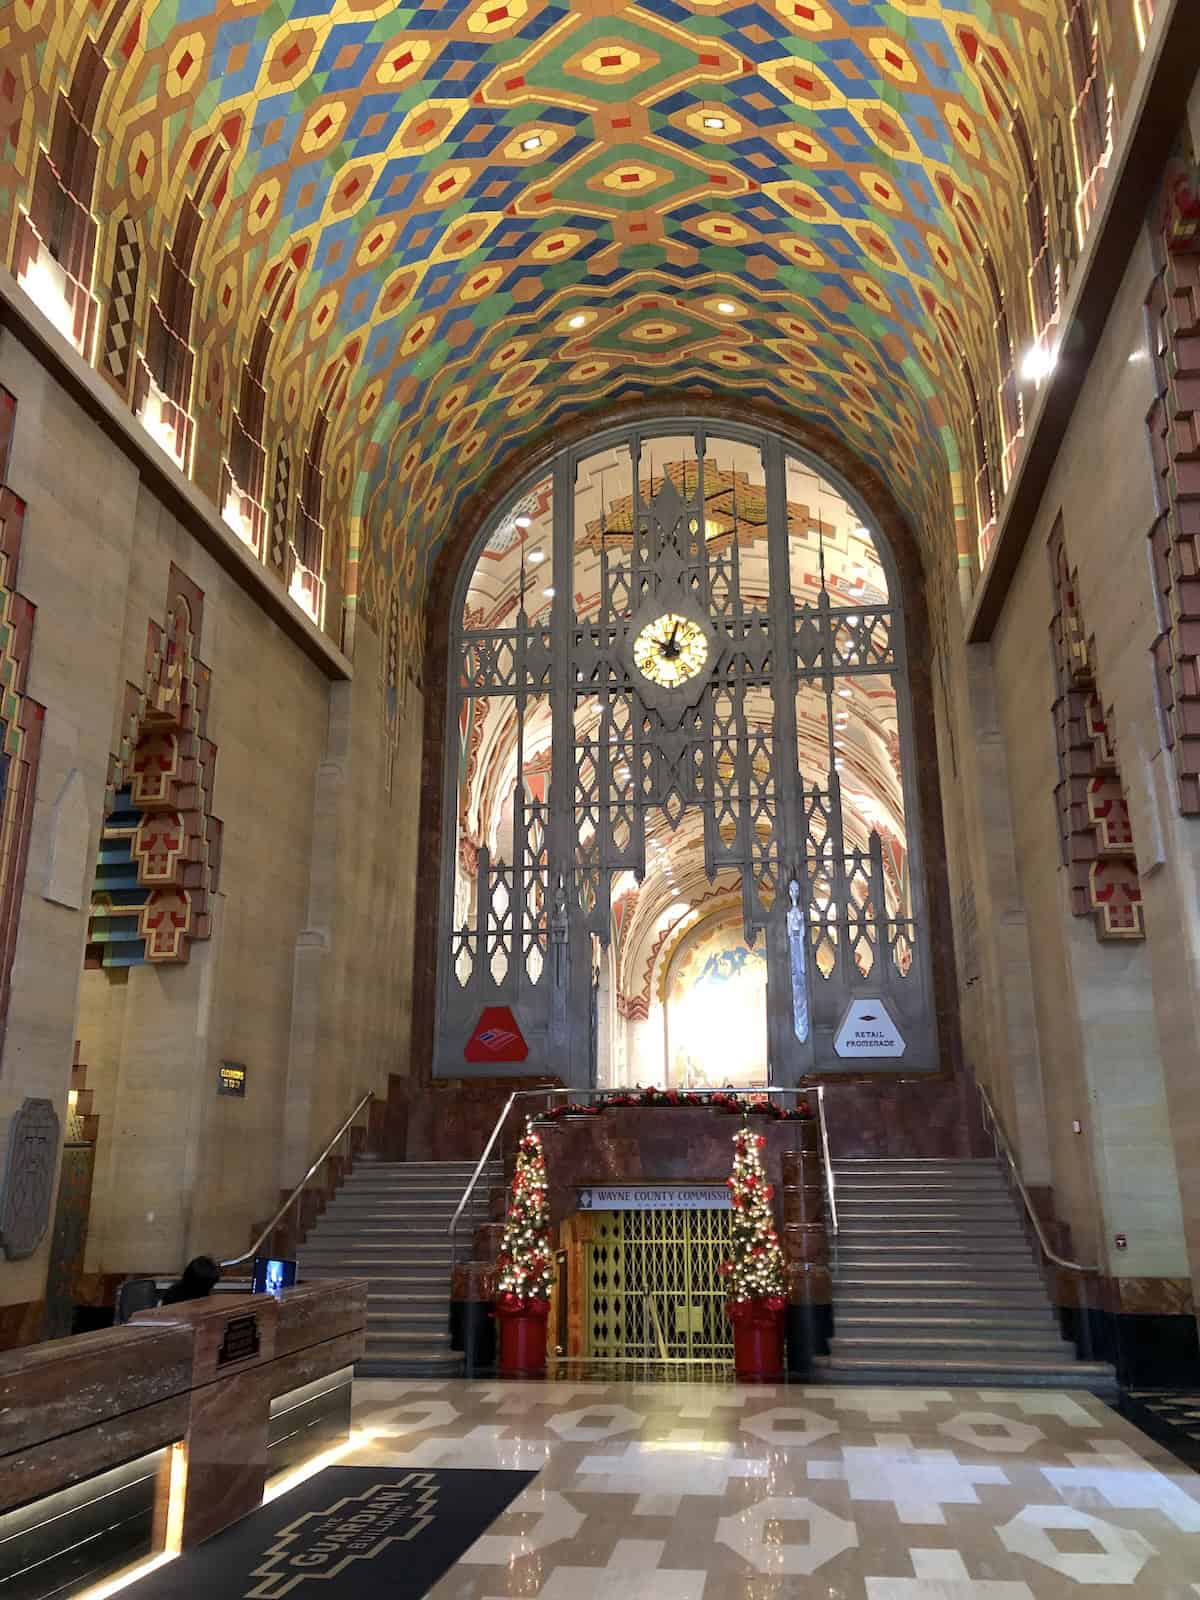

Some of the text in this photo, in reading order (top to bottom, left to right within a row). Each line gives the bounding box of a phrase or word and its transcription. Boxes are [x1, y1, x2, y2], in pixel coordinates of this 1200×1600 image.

[645, 660, 652, 668] 8
[846, 1040, 896, 1048] PROMENADE
[598, 1191, 733, 1201] WAYNE COUNTY COMMISSIO
[289, 1492, 409, 1566] GUARDIAN
[313, 1518, 344, 1533] THE
[346, 1505, 413, 1549] BUILDING
